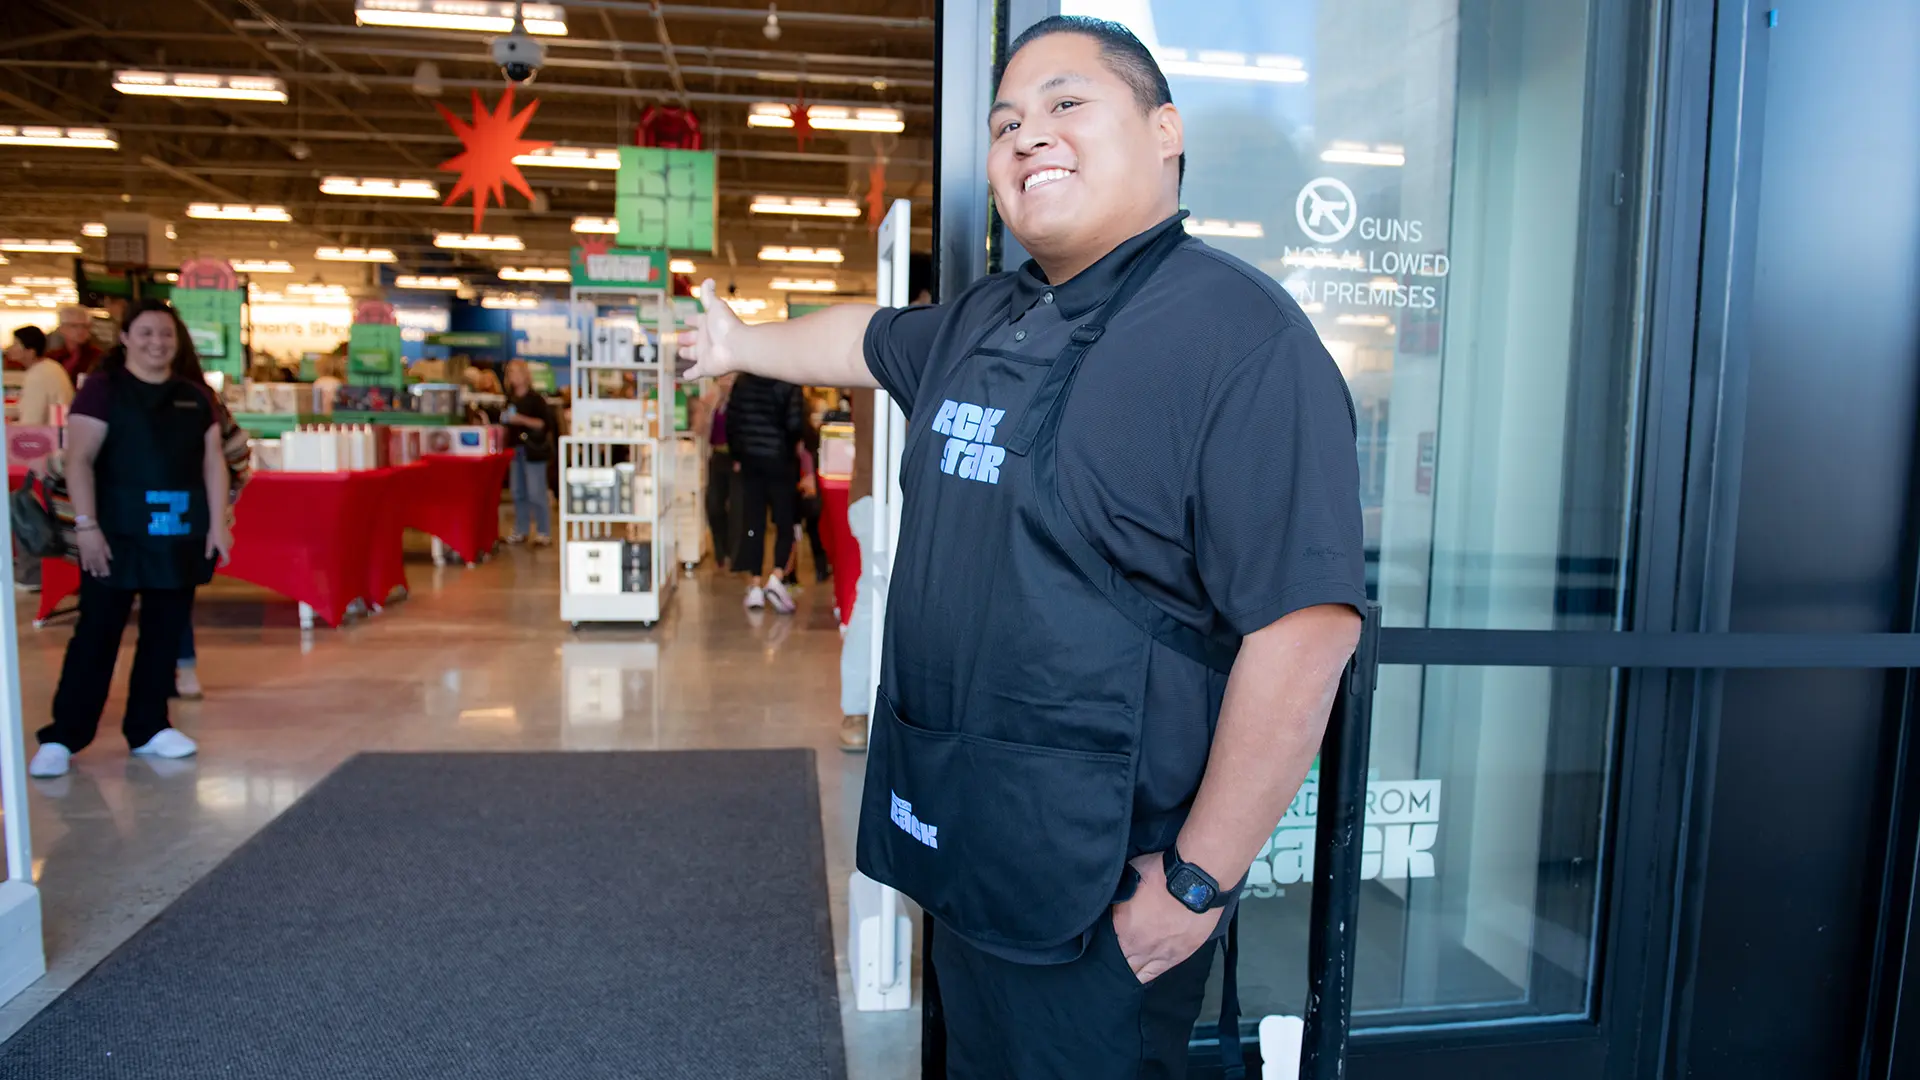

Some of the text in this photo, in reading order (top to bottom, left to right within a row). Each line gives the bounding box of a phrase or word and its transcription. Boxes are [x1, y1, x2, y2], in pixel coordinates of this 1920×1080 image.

[1359, 217, 1423, 243] GUNS
[1283, 245, 1450, 277] NOT ALLOWED
[1323, 281, 1437, 309] PREMISES
